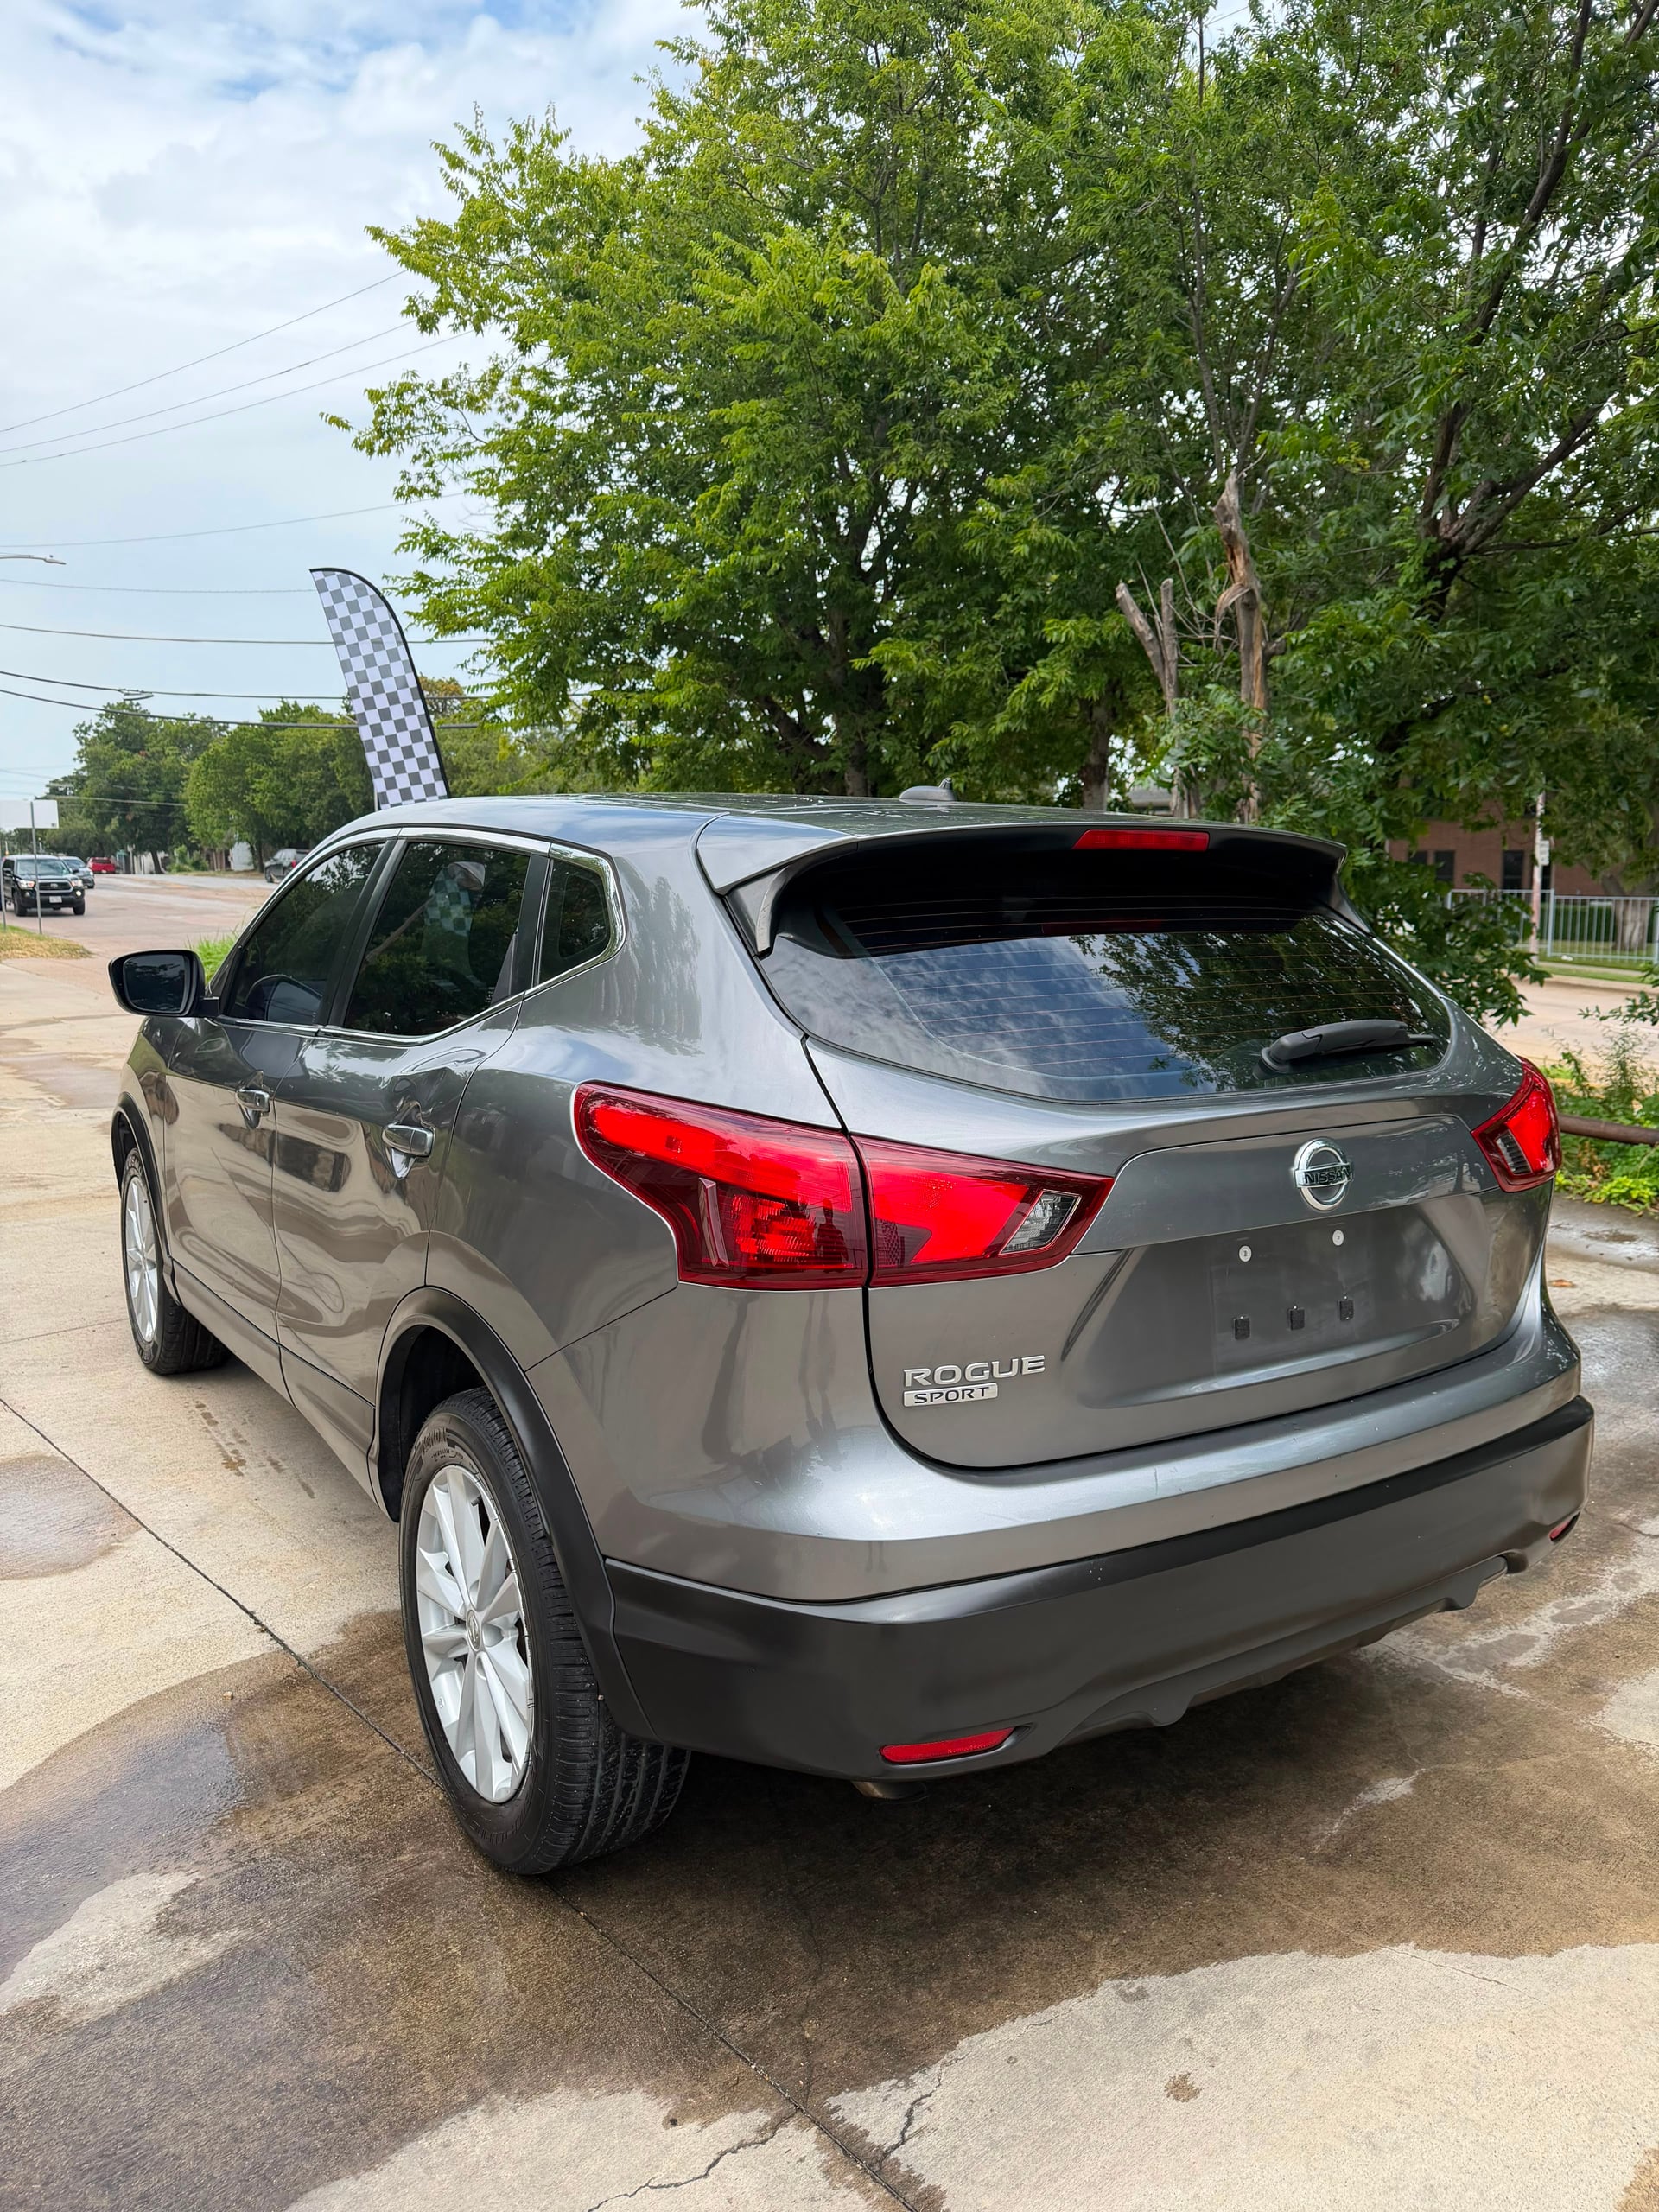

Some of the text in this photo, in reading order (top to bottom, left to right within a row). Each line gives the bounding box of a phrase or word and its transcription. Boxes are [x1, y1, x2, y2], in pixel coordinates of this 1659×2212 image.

[1304, 1166, 1351, 1185] NISSAN
[903, 1355, 1046, 1388] ROGUE
[914, 1386, 989, 1404] SPORT
